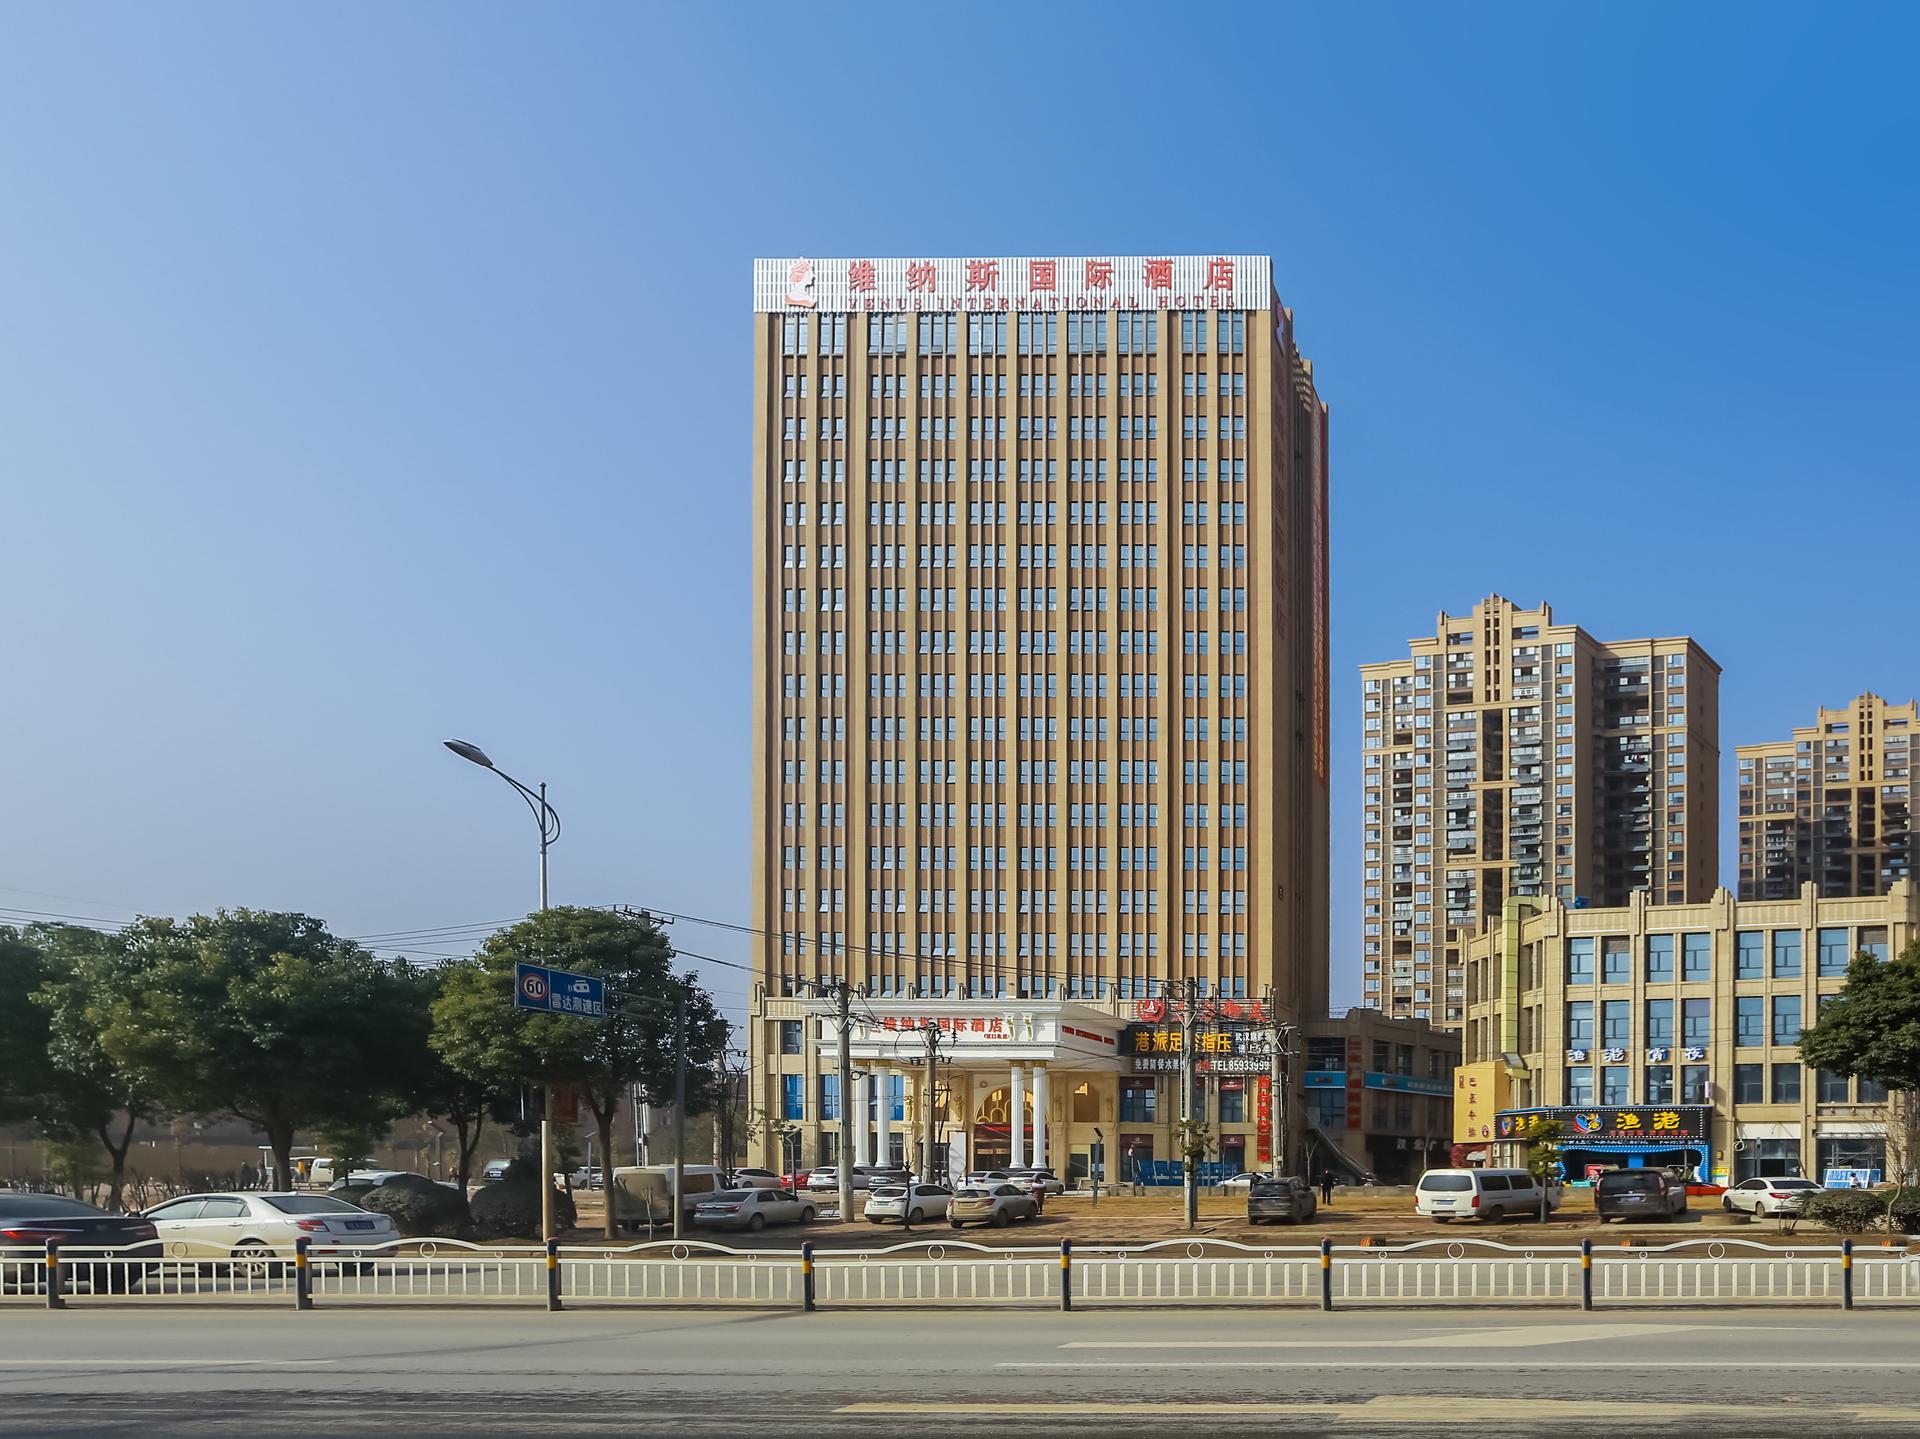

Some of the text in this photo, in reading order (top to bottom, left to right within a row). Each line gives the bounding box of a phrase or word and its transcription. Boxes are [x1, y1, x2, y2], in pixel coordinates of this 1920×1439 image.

[848, 257, 1234, 293] 维纳斯国际酒店
[848, 295, 1235, 311] VENUS INTERNATIONAL HOTEL
[526, 979, 543, 995] 60
[551, 993, 602, 1014] 雷达测速区
[1616, 1111, 1680, 1130] 渔港
